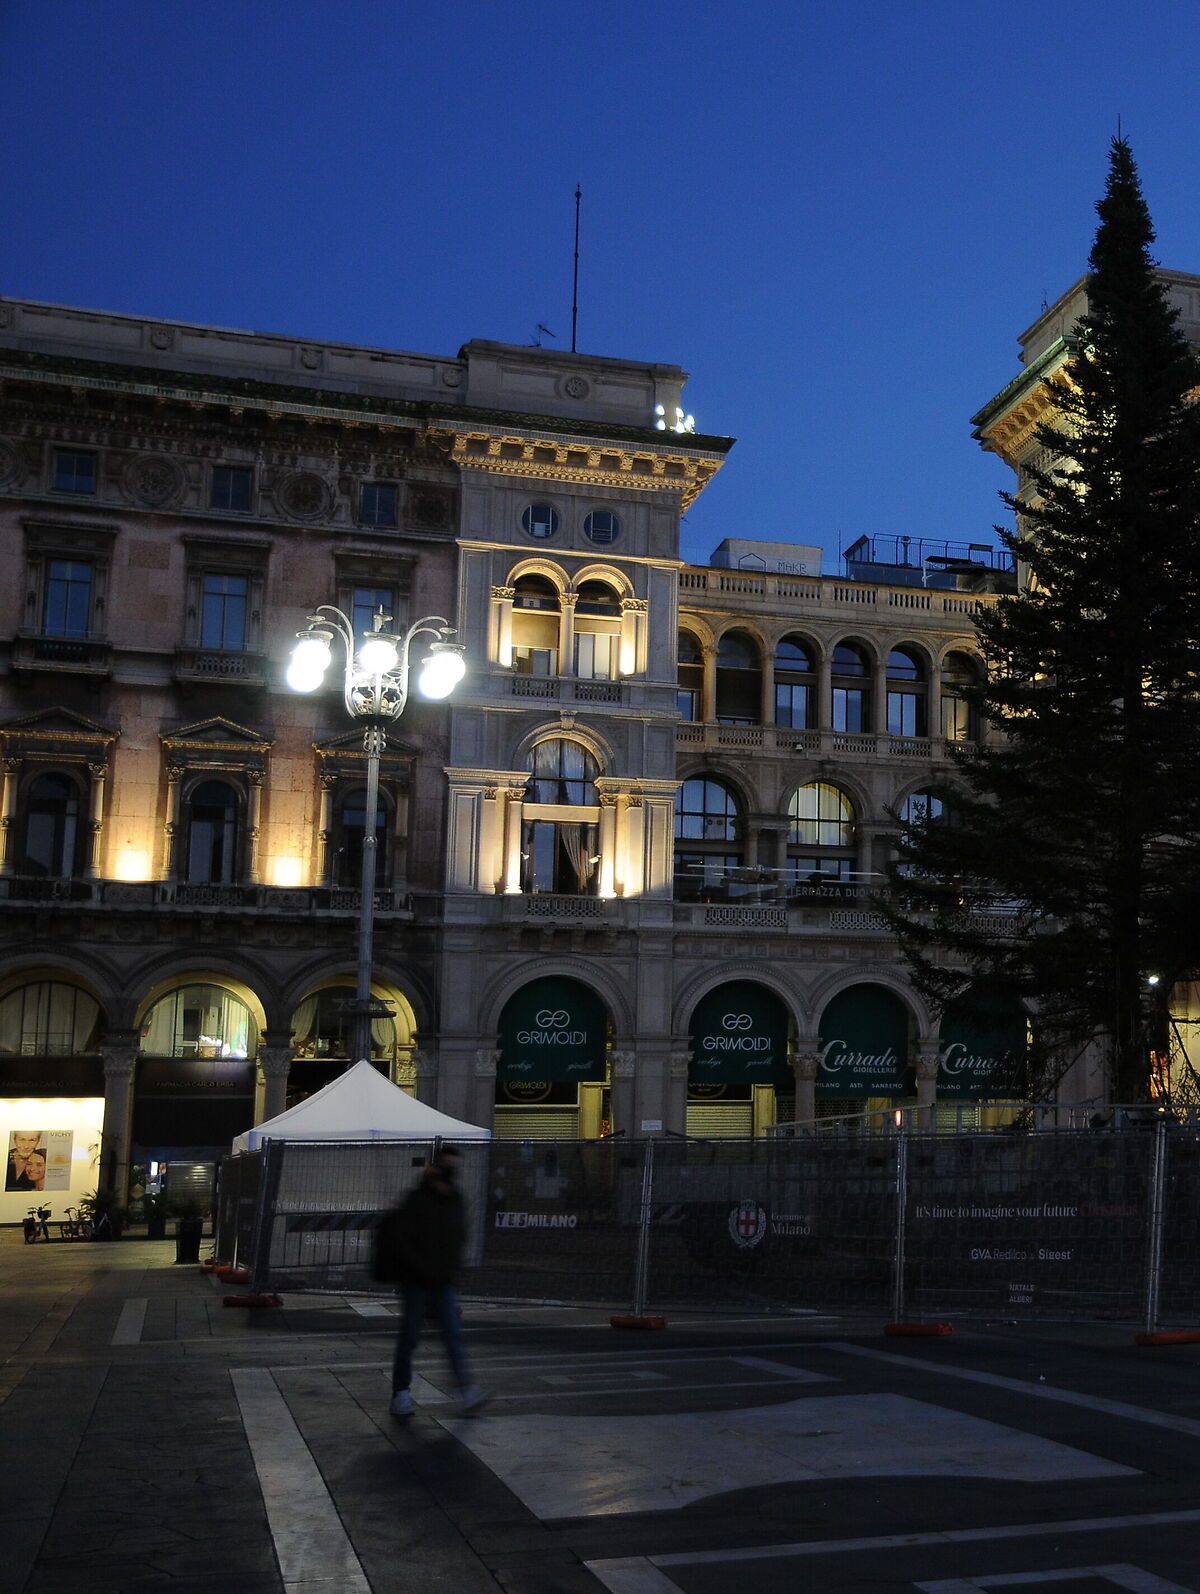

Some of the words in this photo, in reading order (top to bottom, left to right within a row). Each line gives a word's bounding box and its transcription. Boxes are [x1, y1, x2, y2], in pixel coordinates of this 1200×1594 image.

[790, 886, 841, 897] TERRAZZA
[517, 1031, 587, 1045] GRIMOLDI
[702, 1036, 771, 1051] GRIMOLDI
[820, 1040, 897, 1072] Currado
[853, 1066, 897, 1074] GIOIELLERIE
[916, 1205, 931, 1218] It's
[932, 1204, 957, 1218] time
[958, 1206, 969, 1218] to
[971, 1204, 1015, 1221] imagine
[1016, 1207, 1041, 1220] your
[1043, 1203, 1077, 1217] future
[495, 1211, 577, 1228] YESMILANO
[771, 1222, 811, 1235] Milano
[971, 1248, 992, 1260] GVA
[1038, 1248, 1073, 1260] Sigest
